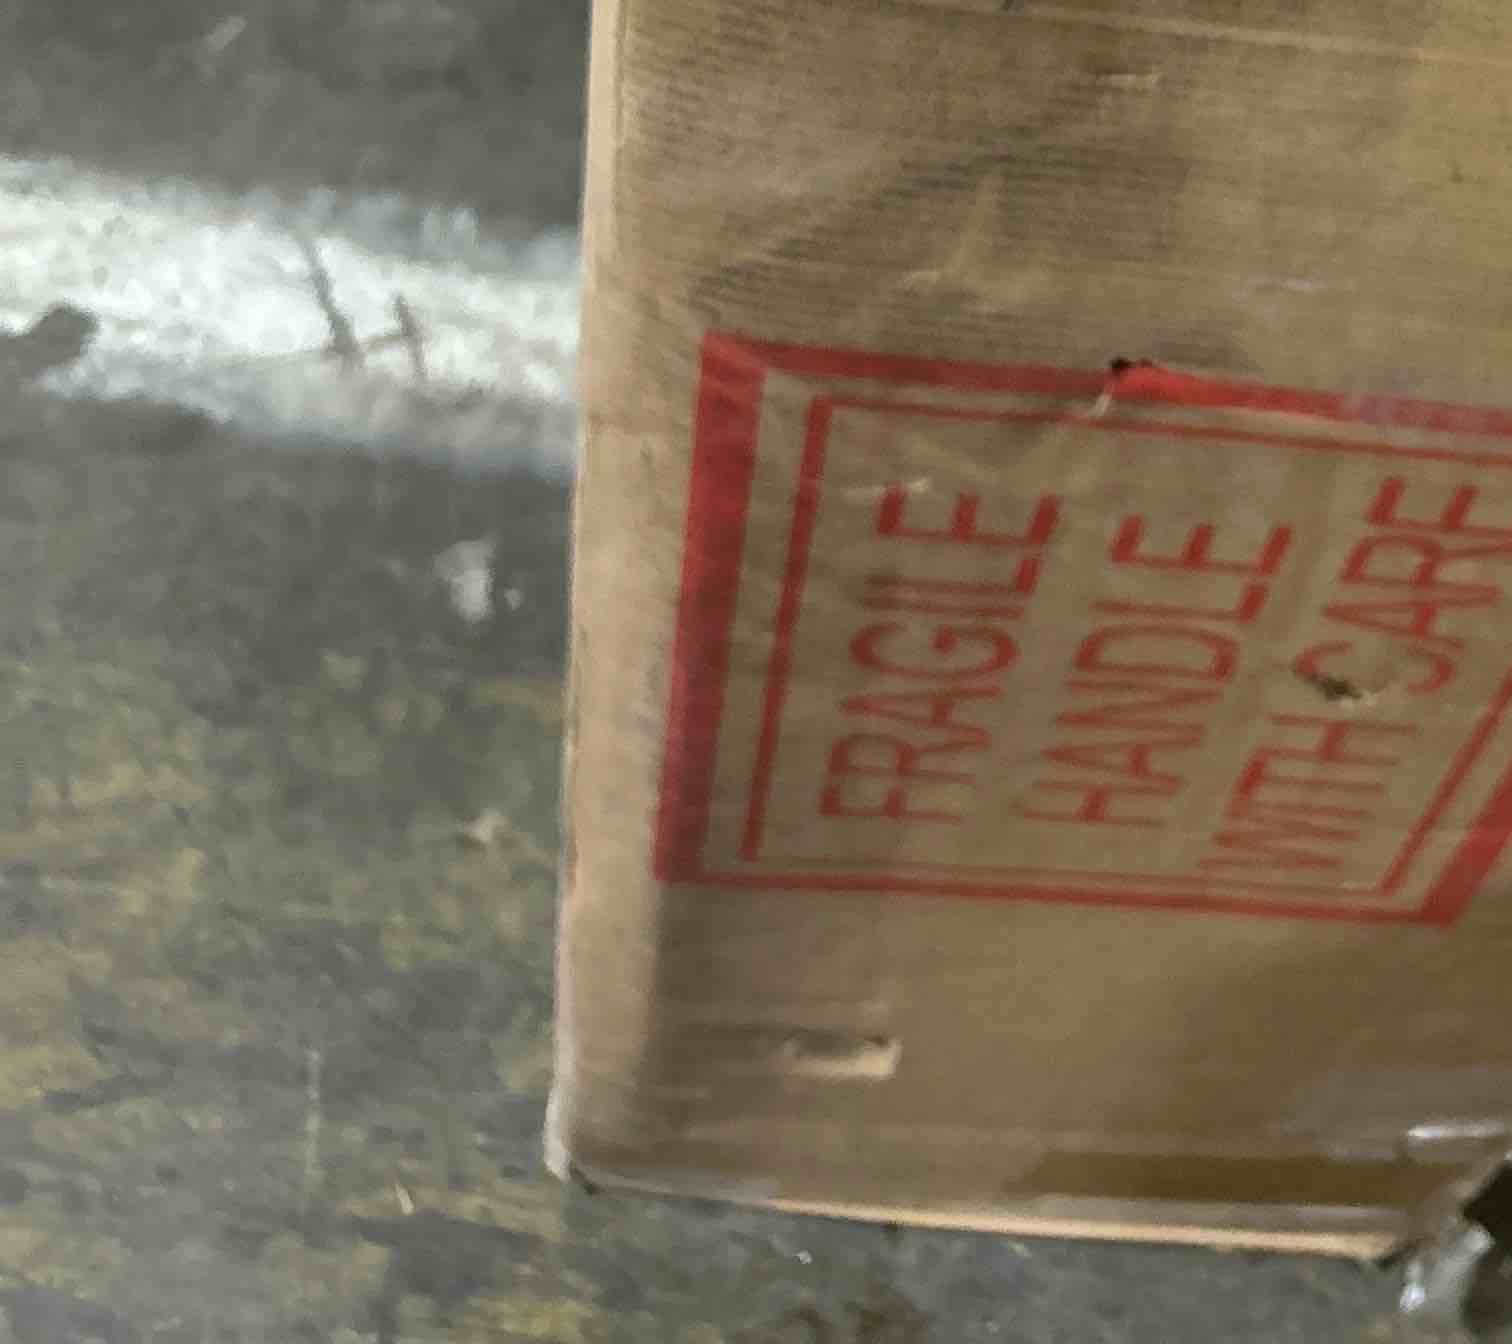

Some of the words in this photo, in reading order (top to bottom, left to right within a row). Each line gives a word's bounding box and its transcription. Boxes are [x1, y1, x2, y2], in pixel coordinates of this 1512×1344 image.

[818, 486, 1062, 826] FRAGILE
[1010, 515, 1293, 829] HANDLE
[1196, 713, 1418, 869] WITH
